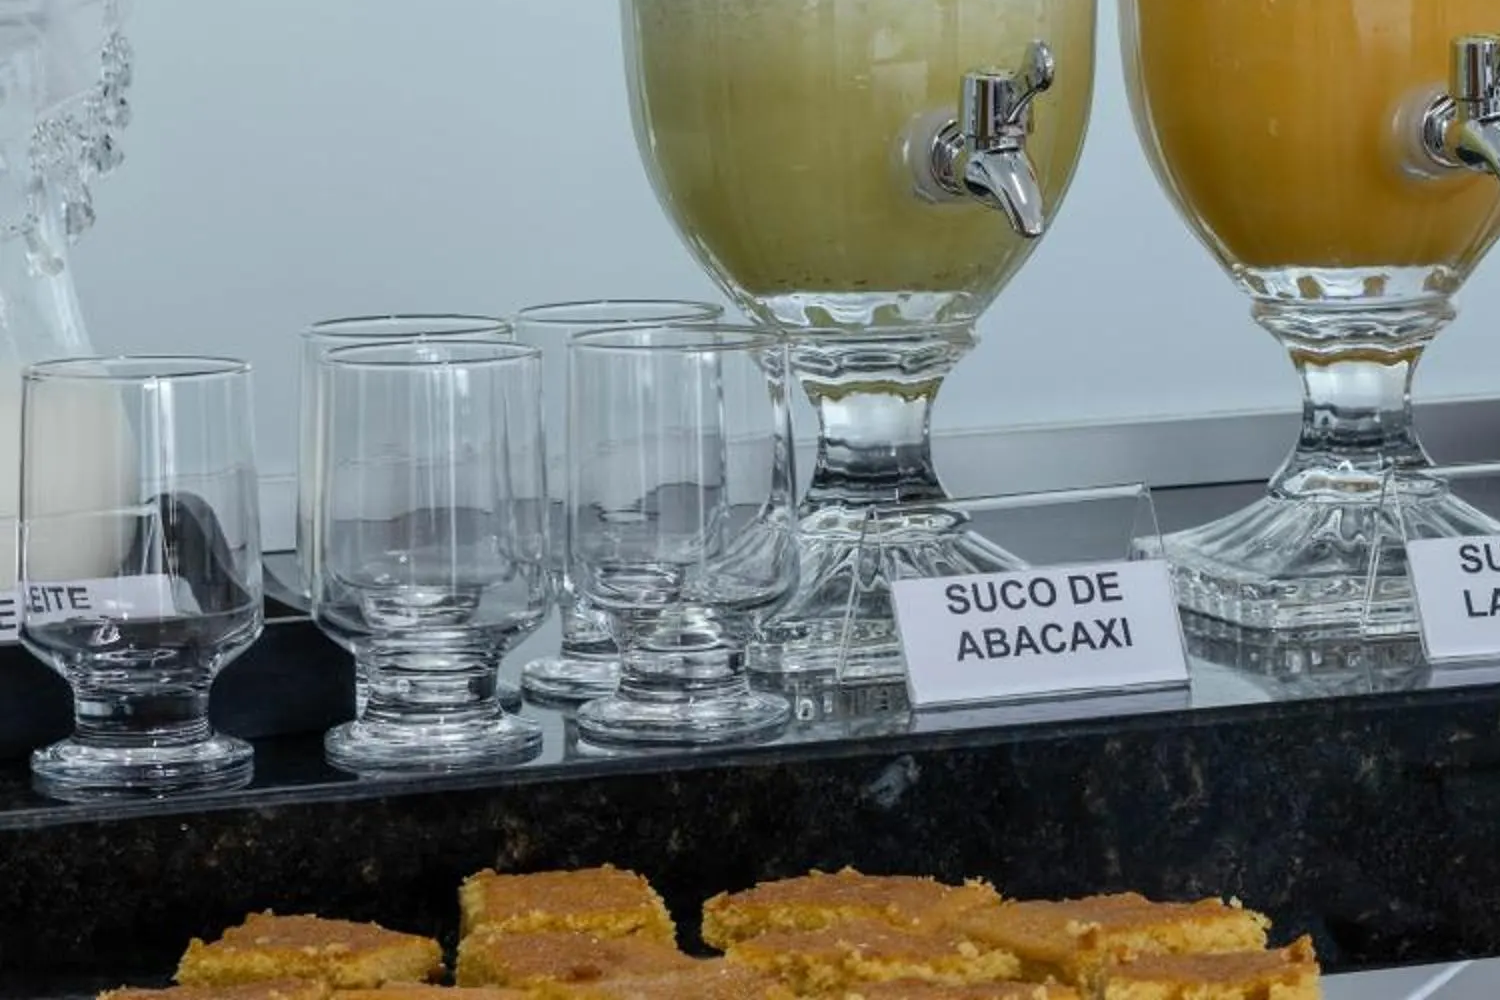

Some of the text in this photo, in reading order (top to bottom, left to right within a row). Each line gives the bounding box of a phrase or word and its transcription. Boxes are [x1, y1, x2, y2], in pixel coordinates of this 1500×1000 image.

[944, 571, 1124, 615] SUCO DE
[956, 617, 1134, 662] ABACAXI
